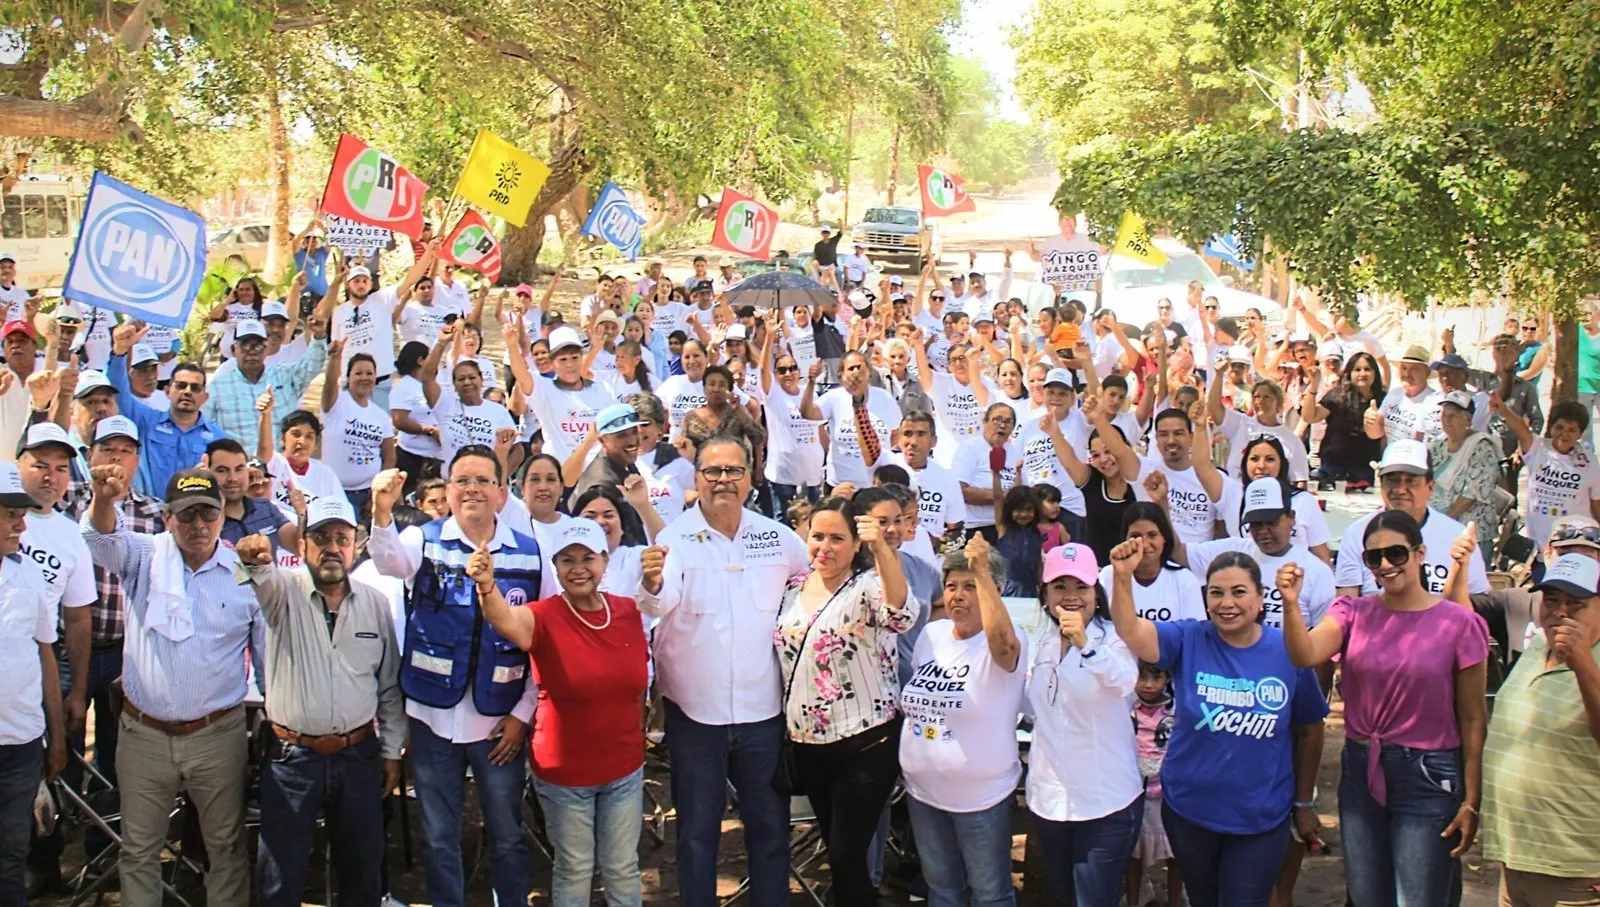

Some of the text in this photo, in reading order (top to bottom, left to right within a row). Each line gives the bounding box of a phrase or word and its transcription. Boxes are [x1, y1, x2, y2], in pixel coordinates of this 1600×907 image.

[351, 157, 408, 206] PRI
[488, 188, 510, 205] PRD
[603, 206, 638, 245] PAN
[728, 209, 763, 241] PRI
[329, 237, 385, 246] PRESIDENTE
[1126, 240, 1148, 257] PRD
[100, 219, 177, 284] PAN
[457, 231, 501, 270] PRI
[1046, 273, 1095, 281] PRESIDENTE
[948, 394, 976, 402] MING
[561, 422, 590, 433] ELVI
[908, 678, 966, 692] AZQUEZ
[1196, 671, 1256, 693] CAMBIEMOS
[903, 695, 963, 709] ESIDENTE
[1197, 684, 1255, 707] EL RUMBO
[1261, 685, 1284, 702] PAN
